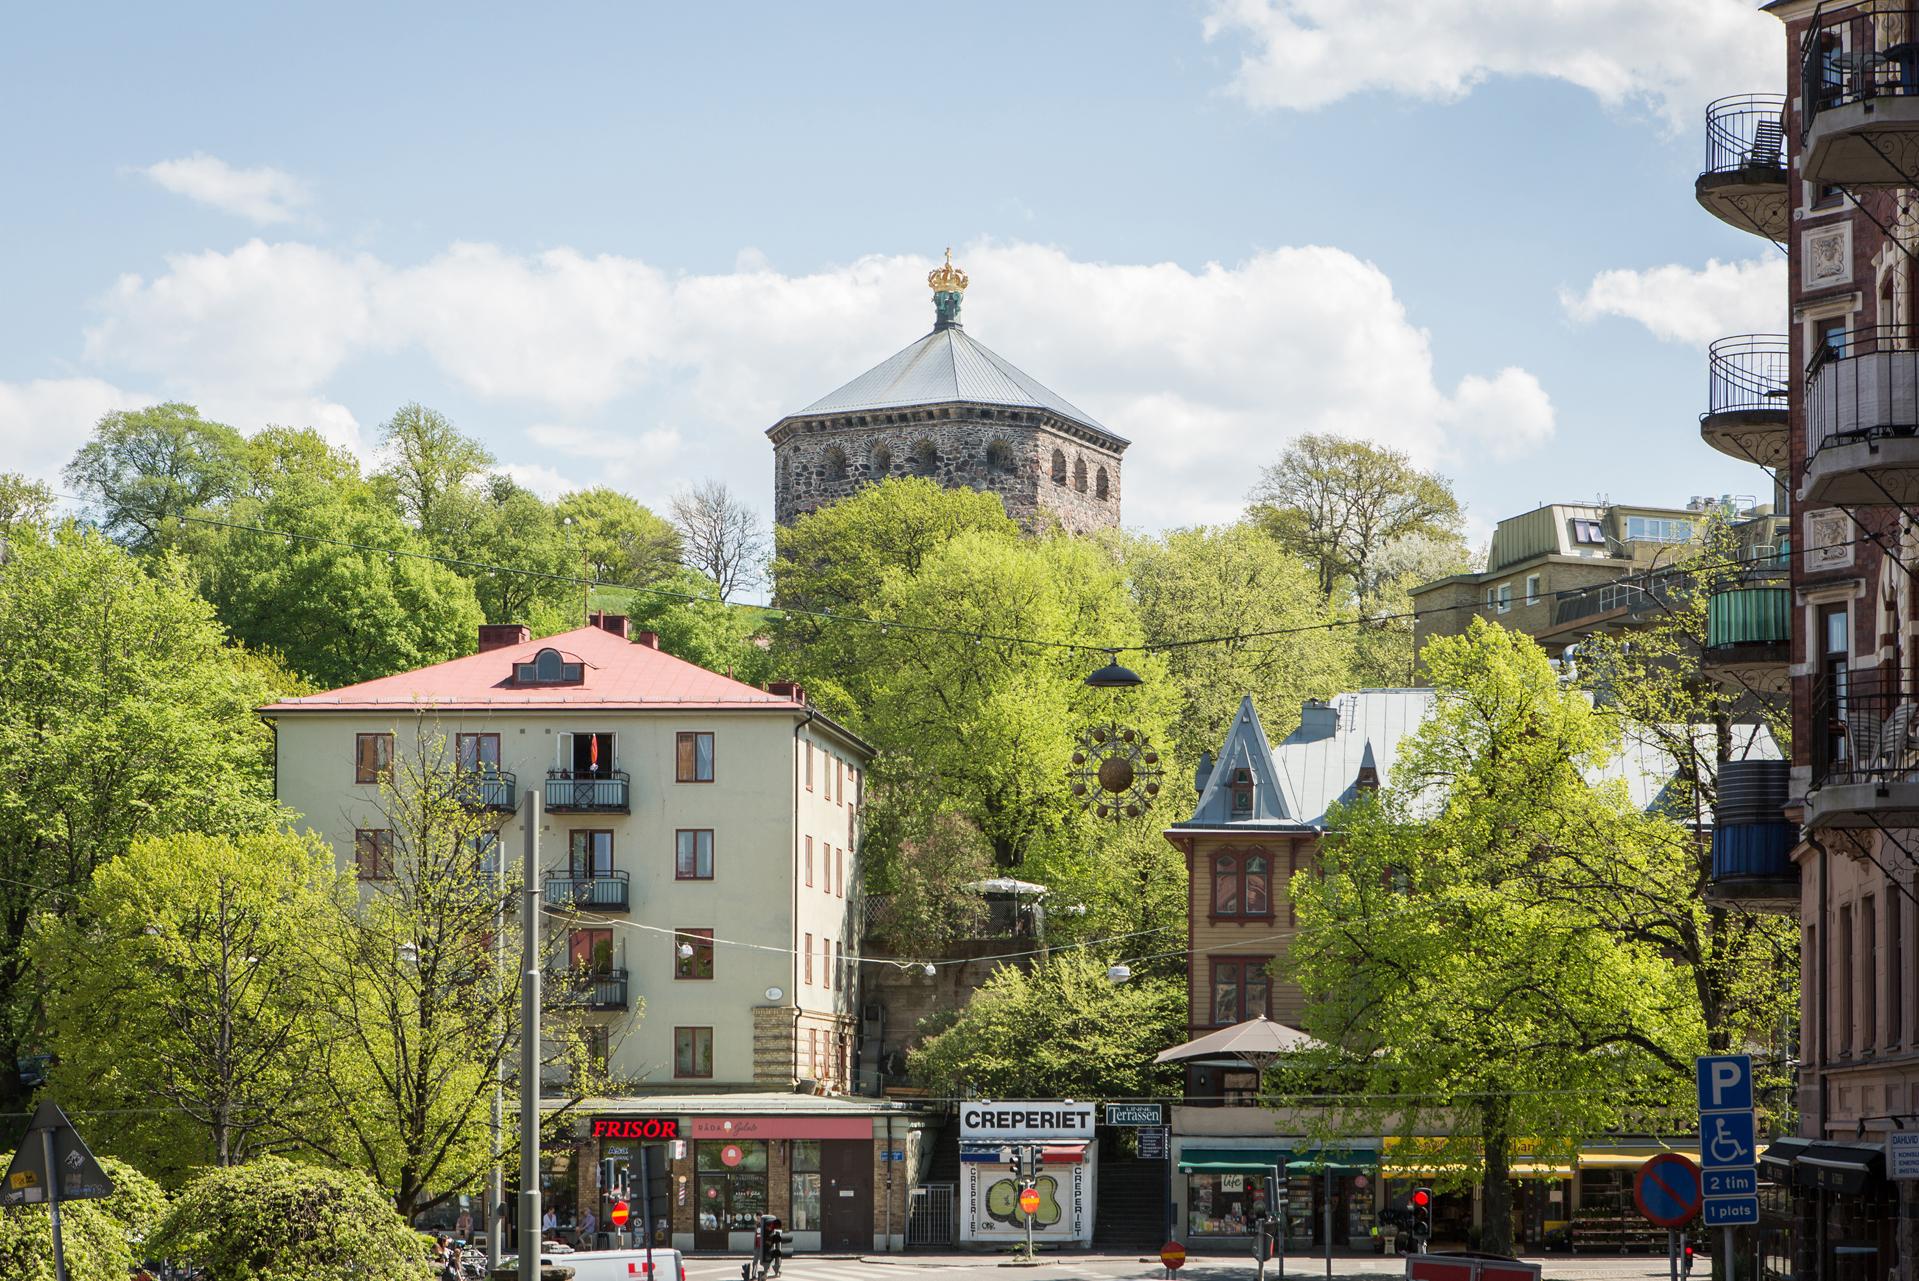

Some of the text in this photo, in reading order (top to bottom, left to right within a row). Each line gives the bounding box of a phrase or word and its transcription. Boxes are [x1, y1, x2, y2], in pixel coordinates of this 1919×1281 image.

[1711, 1061, 1741, 1105] P
[965, 1110, 1090, 1129] CREPERIET
[1109, 1106, 1159, 1124] Terrassen
[592, 1119, 677, 1138] FRISÖR
[1223, 1174, 1242, 1189] life
[1710, 1176, 1749, 1190] 2 tim
[1074, 1167, 1082, 1237] CREPERIET
[1710, 1205, 1751, 1218] 1 plats
